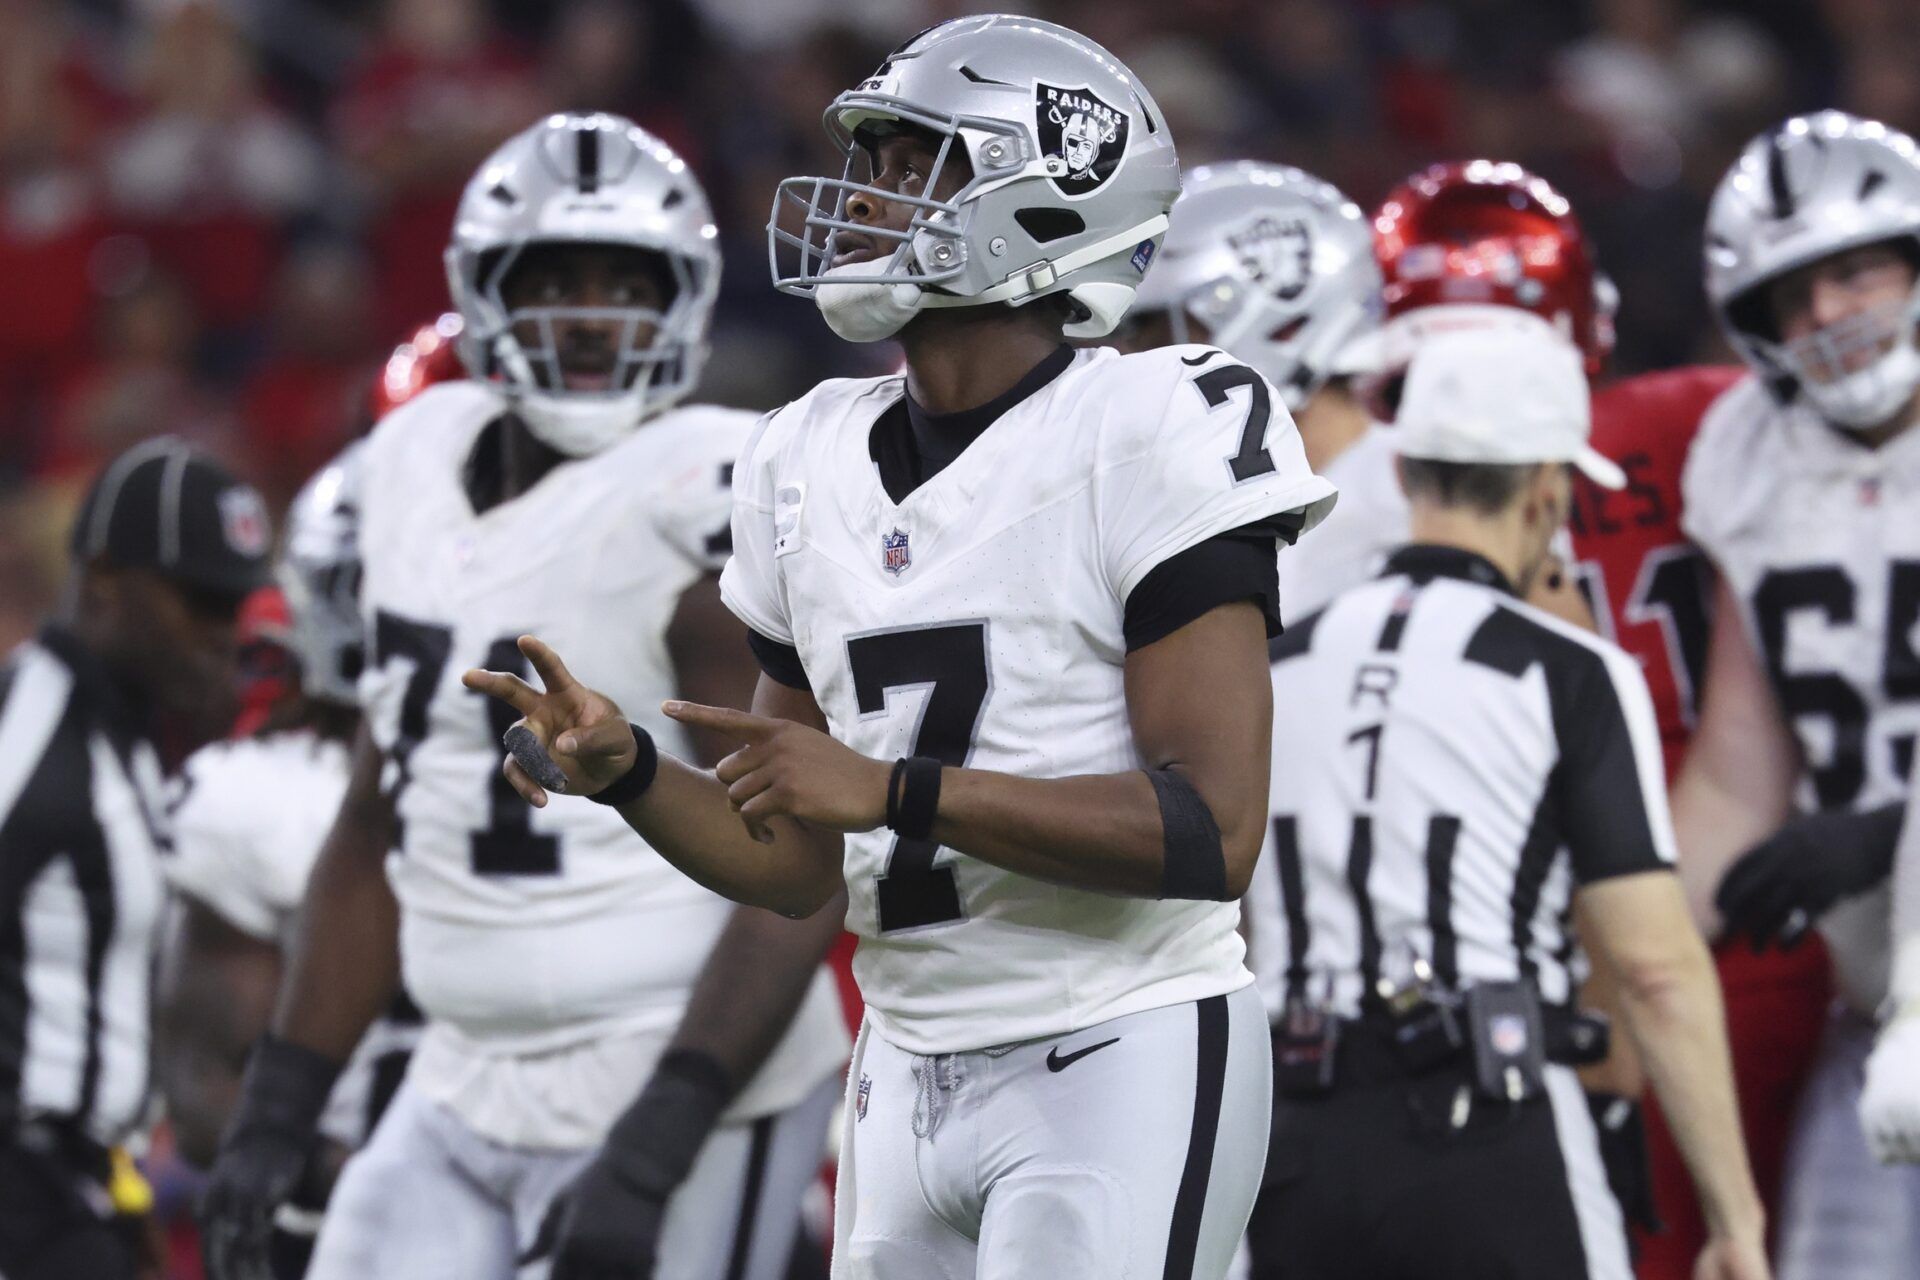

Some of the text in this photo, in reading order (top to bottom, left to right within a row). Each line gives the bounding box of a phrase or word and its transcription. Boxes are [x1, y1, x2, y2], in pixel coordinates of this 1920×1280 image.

[1046, 88, 1122, 126] RAIDERS
[1189, 363, 1279, 487] 7
[886, 548, 906, 567] NFL
[1350, 664, 1399, 708] R
[374, 606, 563, 877] 71
[843, 617, 994, 937] 7
[1346, 722, 1384, 801] 1
